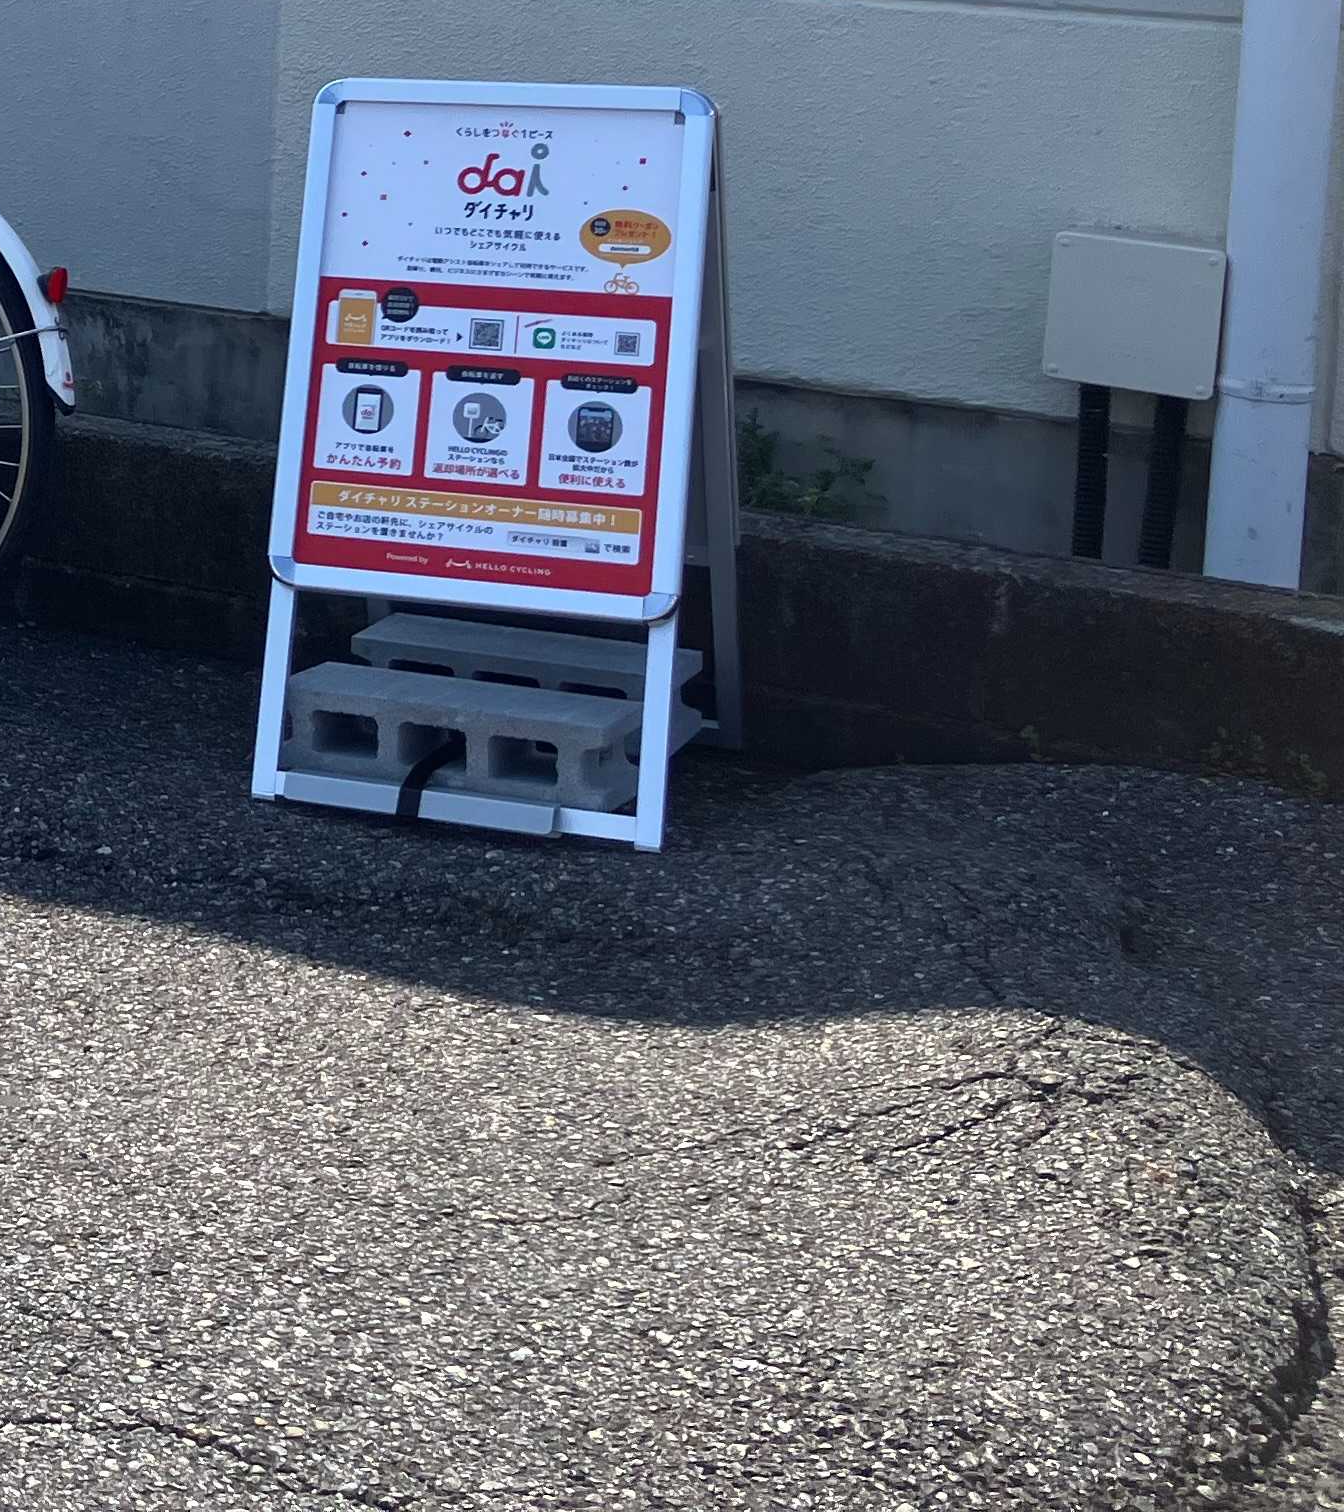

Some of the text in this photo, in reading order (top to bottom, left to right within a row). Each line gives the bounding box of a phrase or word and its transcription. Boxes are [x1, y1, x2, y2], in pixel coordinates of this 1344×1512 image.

[457, 143, 550, 197] dai
[464, 201, 534, 221] ダイチャリ
[469, 240, 527, 252] シェアサイクル
[326, 453, 402, 470] かんたん予約
[559, 473, 626, 488] 便利に使える
[338, 490, 401, 507] ダイチャリ
[386, 552, 429, 565] Powered by
[475, 562, 552, 576] HELLO CYCLING
